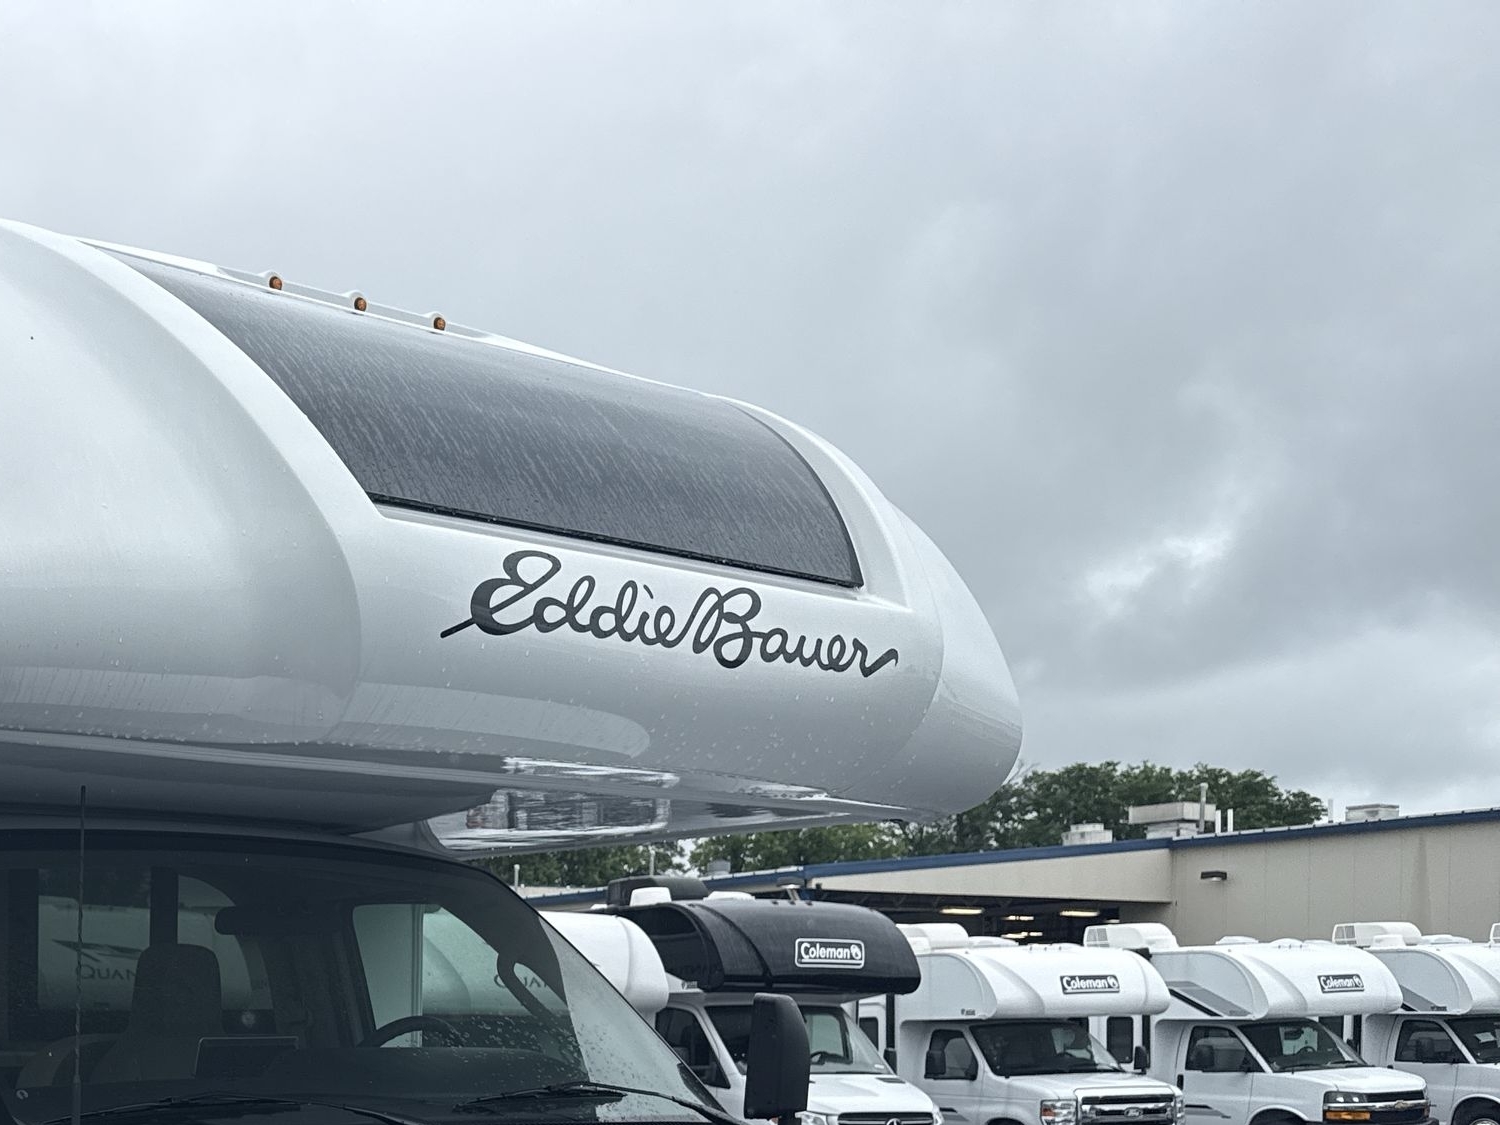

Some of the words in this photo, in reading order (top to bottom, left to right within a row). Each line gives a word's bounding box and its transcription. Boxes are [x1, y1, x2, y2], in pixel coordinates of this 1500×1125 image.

[440, 550, 691, 648] Eddie
[693, 586, 899, 678] Bauer
[800, 942, 851, 960] Coleman
[1062, 976, 1109, 990] Coleman
[1320, 976, 1356, 989] Coleman
